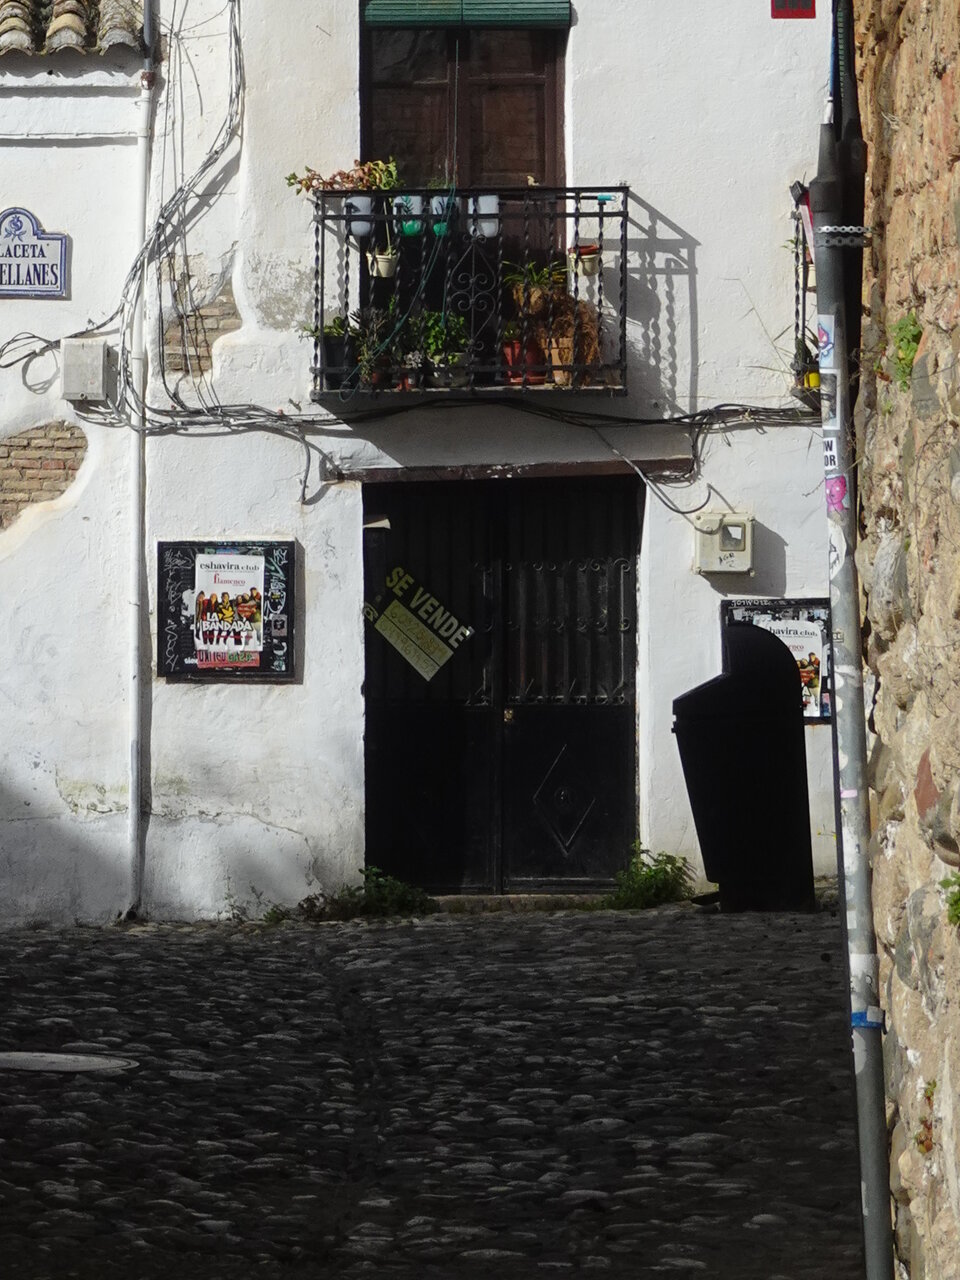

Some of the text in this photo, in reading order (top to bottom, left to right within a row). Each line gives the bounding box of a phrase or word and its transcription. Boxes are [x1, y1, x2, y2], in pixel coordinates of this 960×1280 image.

[200, 561, 240, 570] eshavira
[213, 573, 246, 585] flamenco
[386, 567, 414, 597] SE
[409, 586, 472, 649] VENDE
[206, 612, 219, 621] LA
